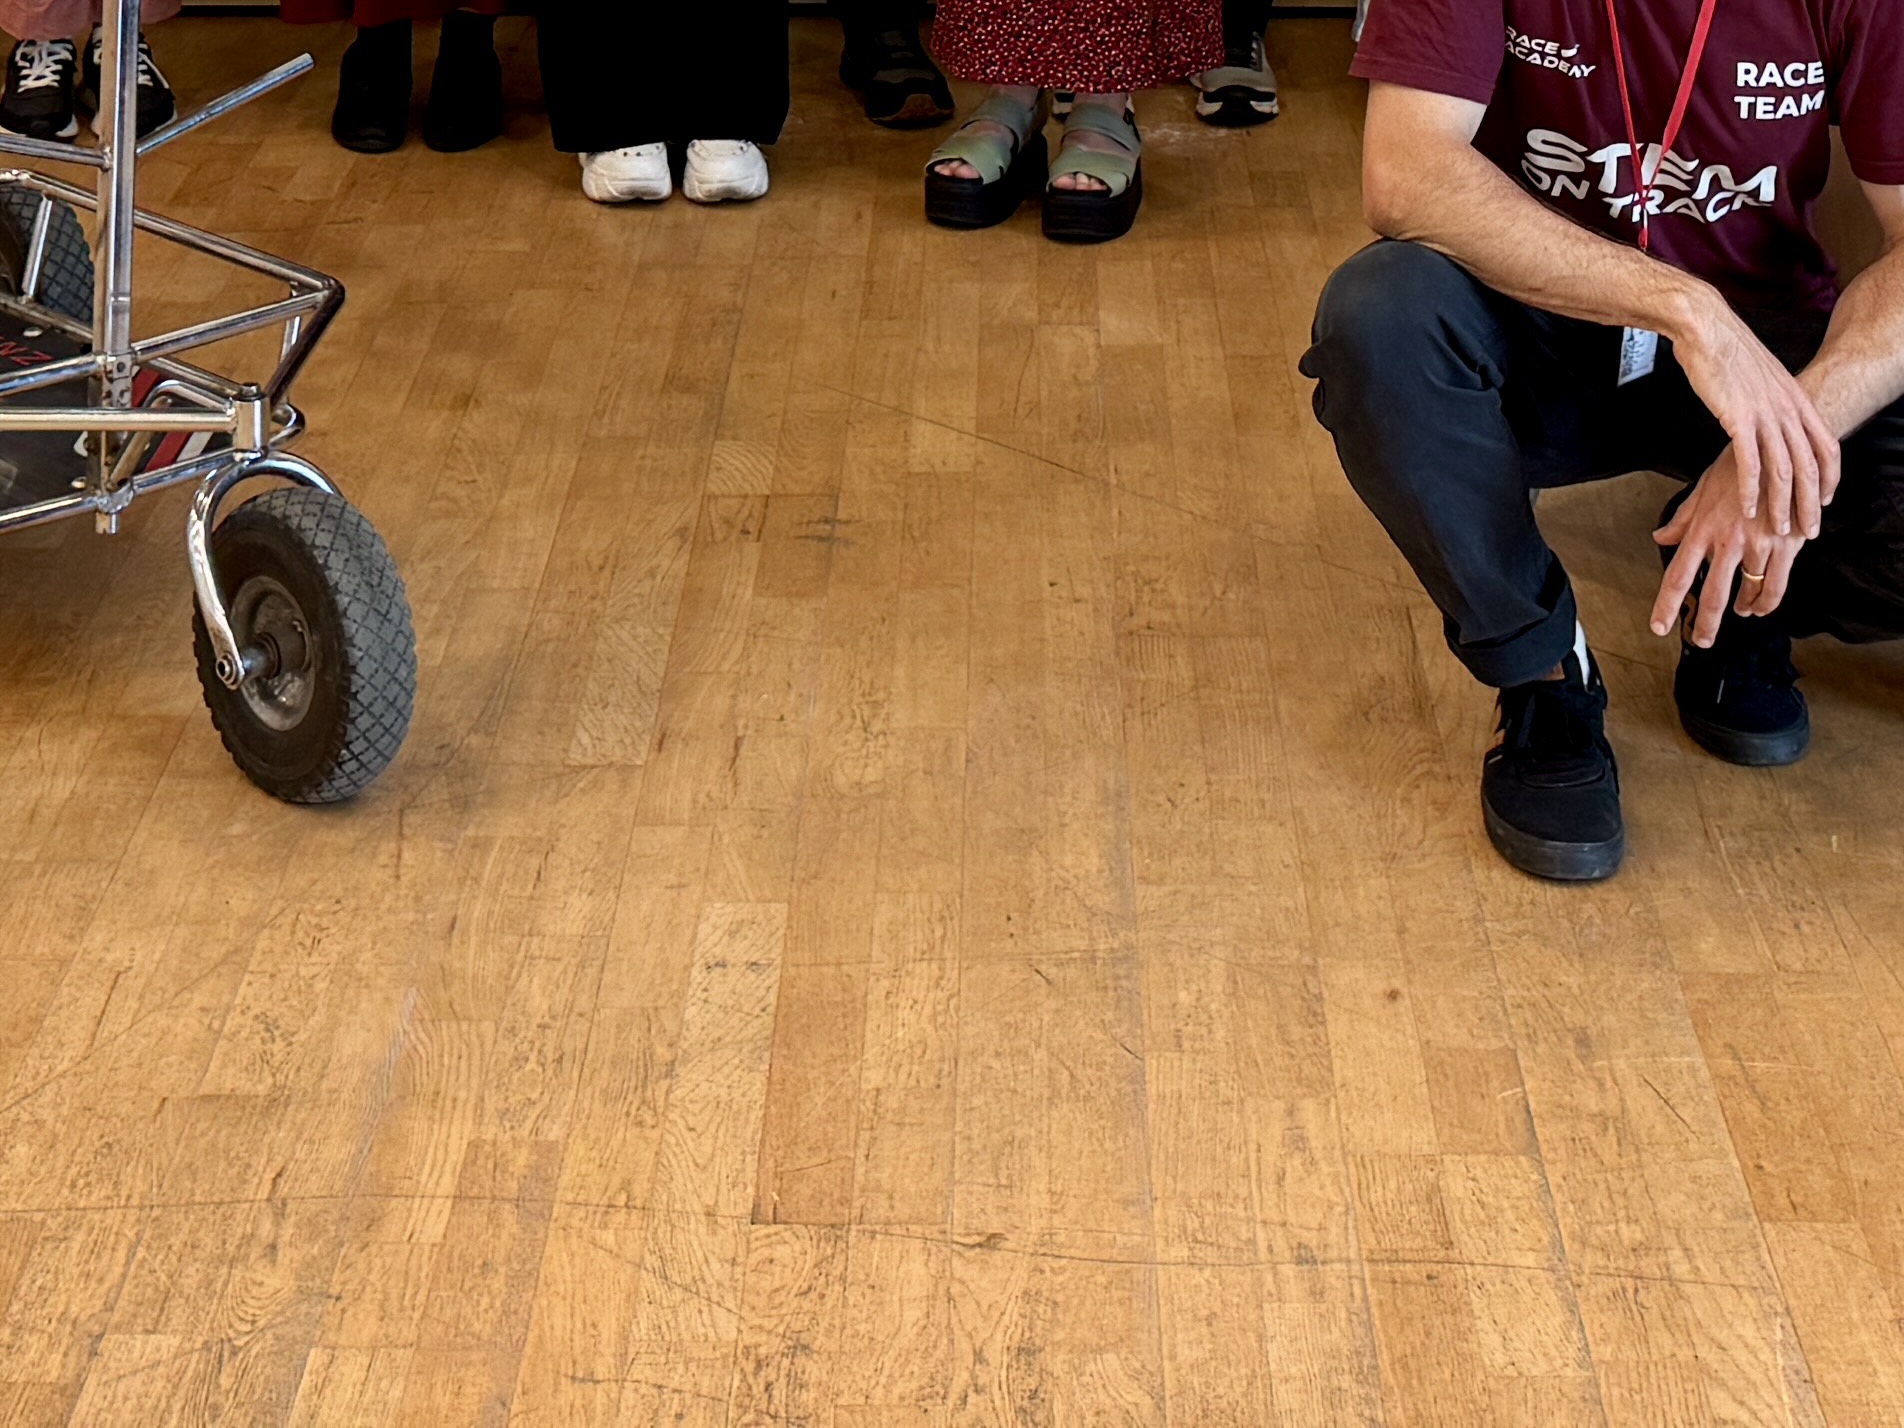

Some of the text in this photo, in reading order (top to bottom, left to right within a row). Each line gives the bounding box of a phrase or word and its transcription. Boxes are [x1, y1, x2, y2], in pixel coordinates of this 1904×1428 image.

[1505, 25, 1560, 55] RACE
[1504, 40, 1597, 79] ACADEMY
[1735, 60, 1825, 88] RACE
[1733, 89, 1825, 121] TEAM
[1520, 158, 1591, 200] ON
[1523, 127, 1778, 203] STEM
